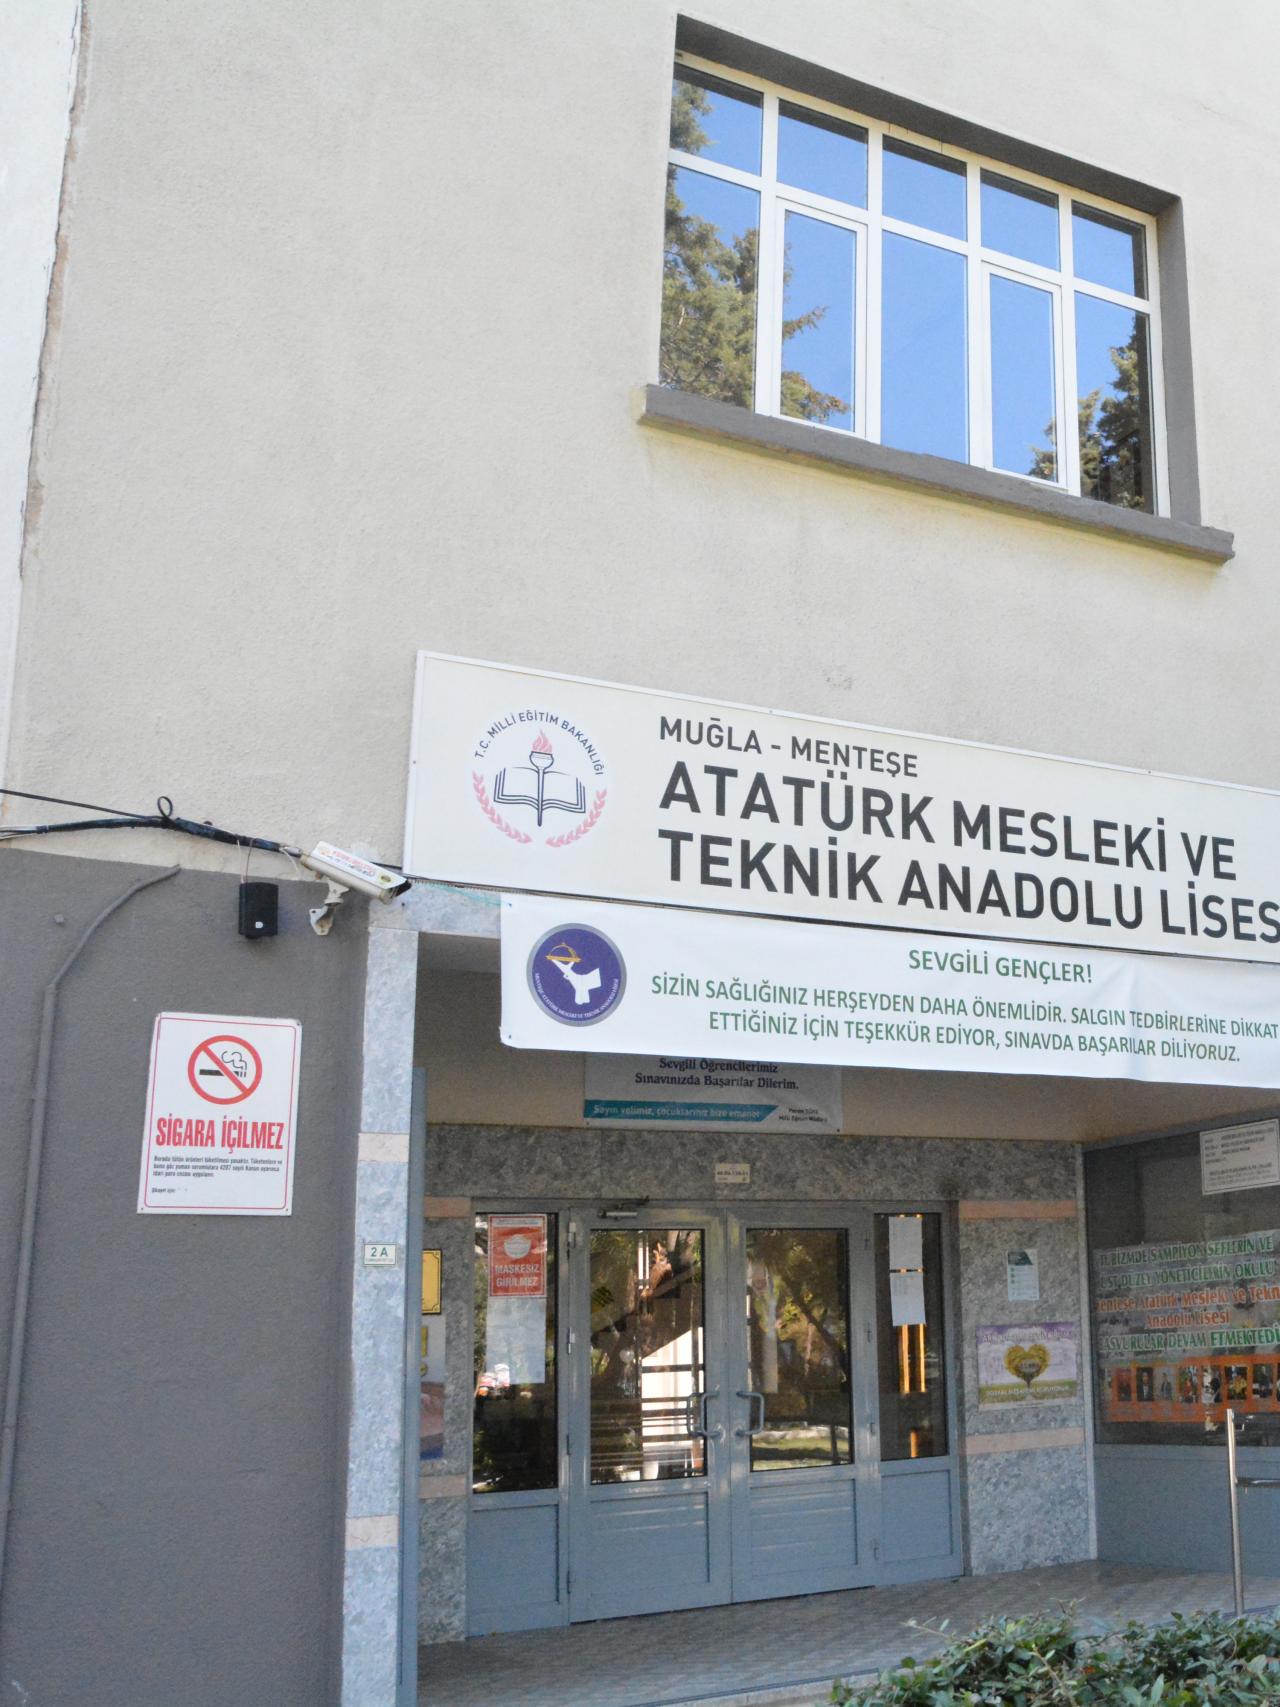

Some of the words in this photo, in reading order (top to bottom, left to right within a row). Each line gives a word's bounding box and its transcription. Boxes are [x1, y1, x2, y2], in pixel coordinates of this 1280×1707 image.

[474, 740, 492, 760] T.C.
[487, 713, 516, 738] MİLLİ
[518, 709, 560, 726] EĞİTİM
[560, 719, 605, 776] BAKANLIĞI
[659, 715, 763, 755] MUĞLA
[770, 743, 781, 751] -
[791, 735, 919, 778] MENTEŞE
[658, 760, 937, 845] ATATÜRK
[953, 799, 1168, 874] MESLEKİ
[1180, 831, 1237, 882] VE
[658, 828, 884, 905] TEKNİK
[897, 859, 1144, 931] ANADOLU
[908, 949, 989, 975] SEVGİLİ
[995, 957, 1093, 985] GENÇLER!
[651, 971, 700, 998] SİZİN
[705, 976, 808, 1006] SAĞLIĞINIZ
[813, 988, 915, 1014] HERŞEYDEN
[920, 996, 968, 1017] DAHA
[972, 996, 1067, 1024] ÖNEMLİDİR.
[1070, 1007, 1126, 1026] SALGIN
[1129, 1010, 1228, 1035] TEDBİRLERİNE
[1230, 1017, 1279, 1039] DİKKAT
[709, 1009, 798, 1036] ETTİĞİNİZ
[803, 1013, 839, 1041] İÇİN
[844, 1020, 931, 1044] TEŞEKKÜR
[936, 1023, 1000, 1050] EDİYOR,
[1004, 1030, 1073, 1051] SINAVDA
[1078, 1035, 1156, 1057] BAŞARILAR
[1161, 1037, 1241, 1062] DİLİYORUZ.
[635, 1072, 700, 1086] Sınavınızda
[703, 1076, 754, 1088] Başarılar
[757, 1077, 799, 1089] Dilerim.
[659, 1058, 697, 1072] Sevgili
[699, 1058, 778, 1073] Öğrencilerimiz
[155, 1113, 216, 1148] SİGARA
[220, 1115, 285, 1154] İÇİLMEZ
[370, 1246, 377, 1257] 2
[380, 1246, 388, 1257] A
[495, 1263, 540, 1274] MASKESİZ
[496, 1276, 539, 1289] GİRİLMEZ
